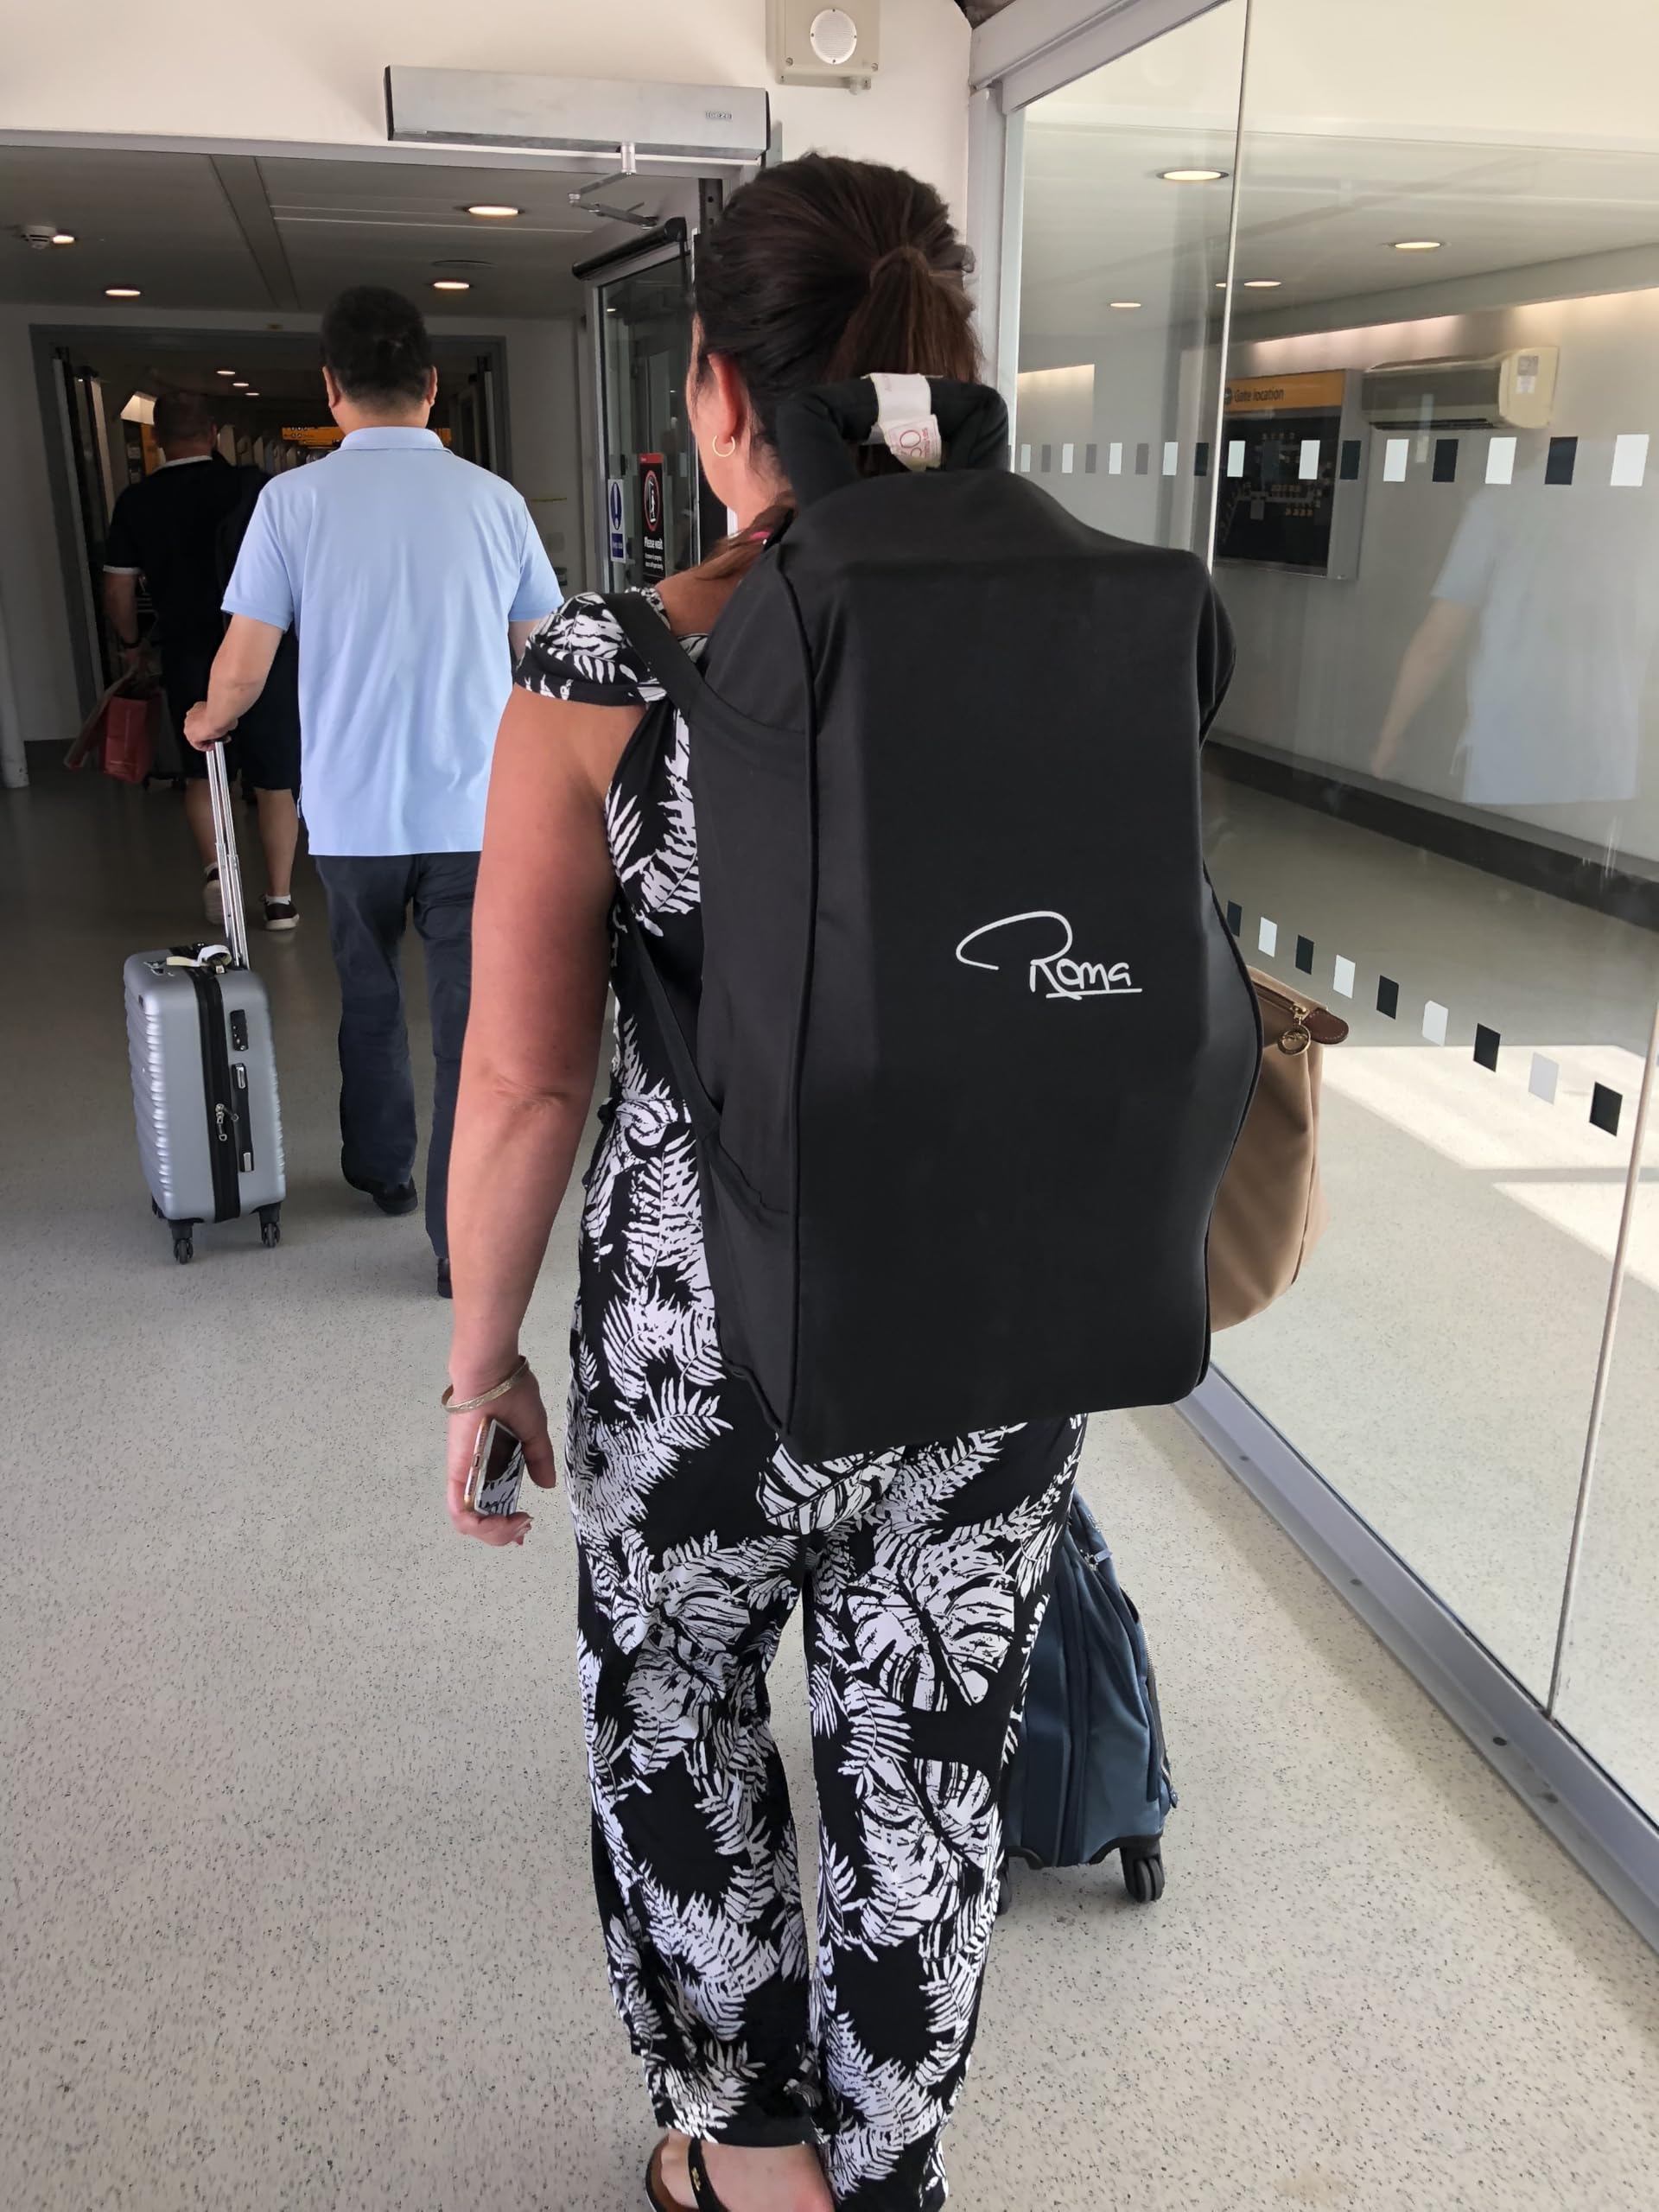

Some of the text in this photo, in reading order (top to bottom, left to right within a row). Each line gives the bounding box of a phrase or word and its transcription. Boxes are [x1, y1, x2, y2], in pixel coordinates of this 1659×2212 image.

[1235, 387, 1284, 403] Gate location
[956, 910, 1142, 1001] Roma
